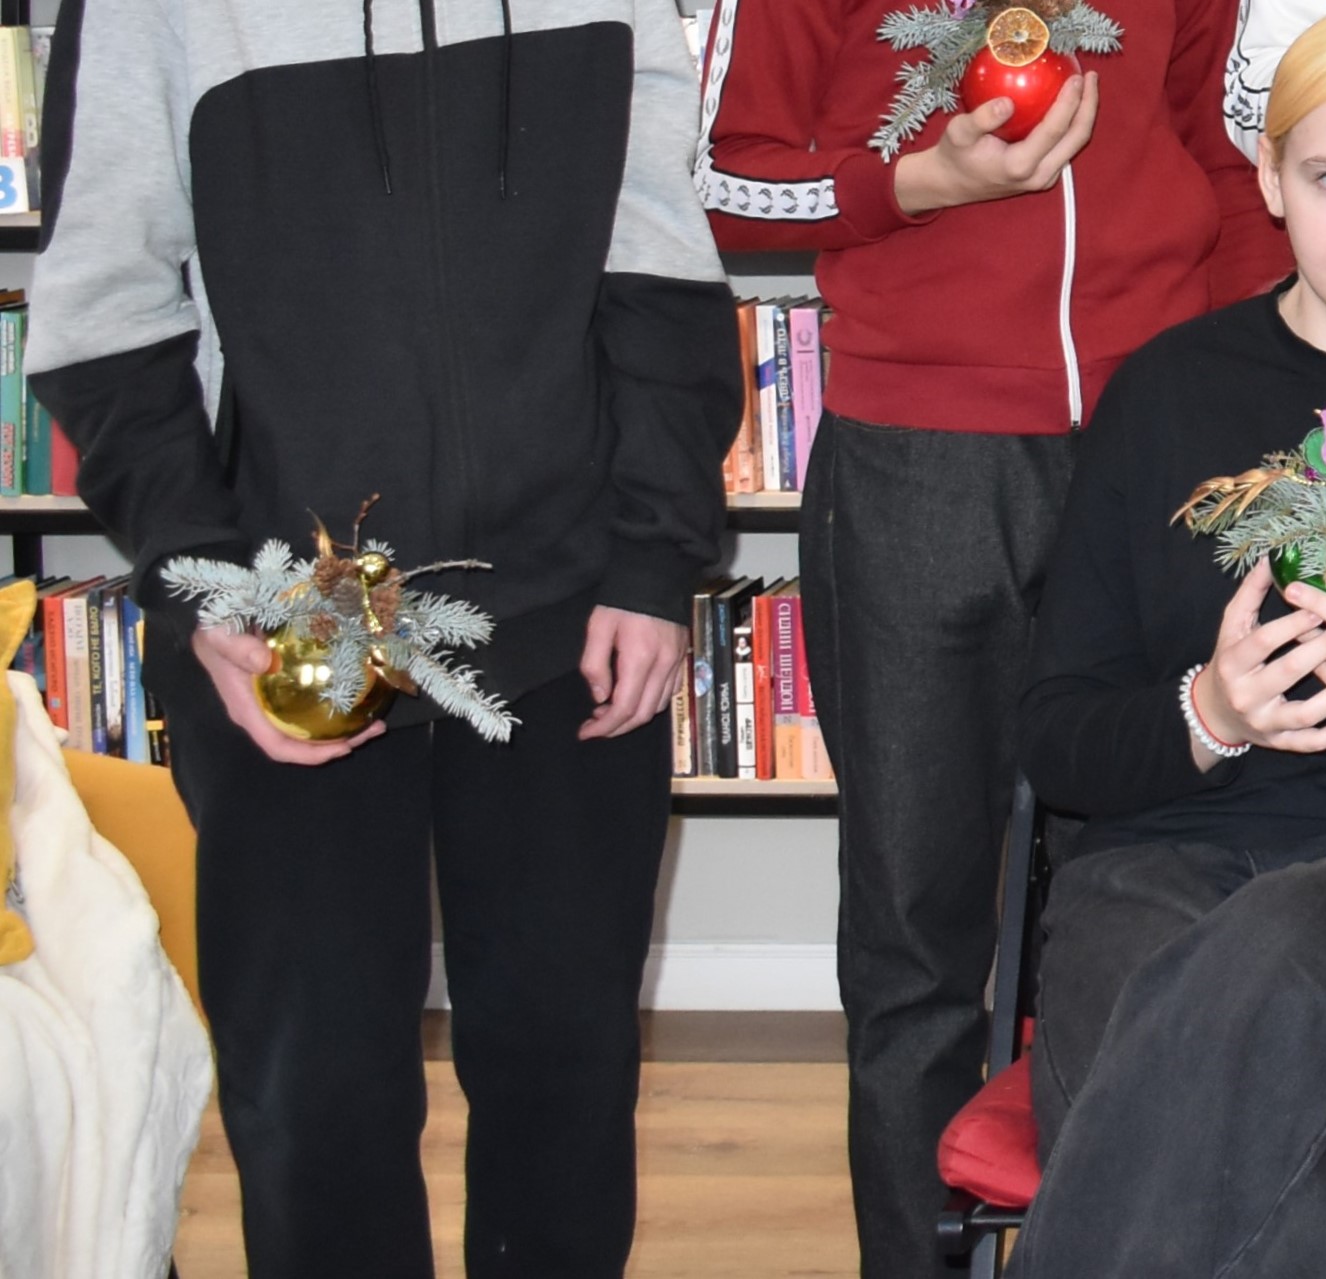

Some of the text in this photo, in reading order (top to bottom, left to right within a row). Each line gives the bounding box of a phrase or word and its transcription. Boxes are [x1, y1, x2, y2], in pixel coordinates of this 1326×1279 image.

[88, 606, 103, 695] ТЕ, КОГО НЕ БЫЛО
